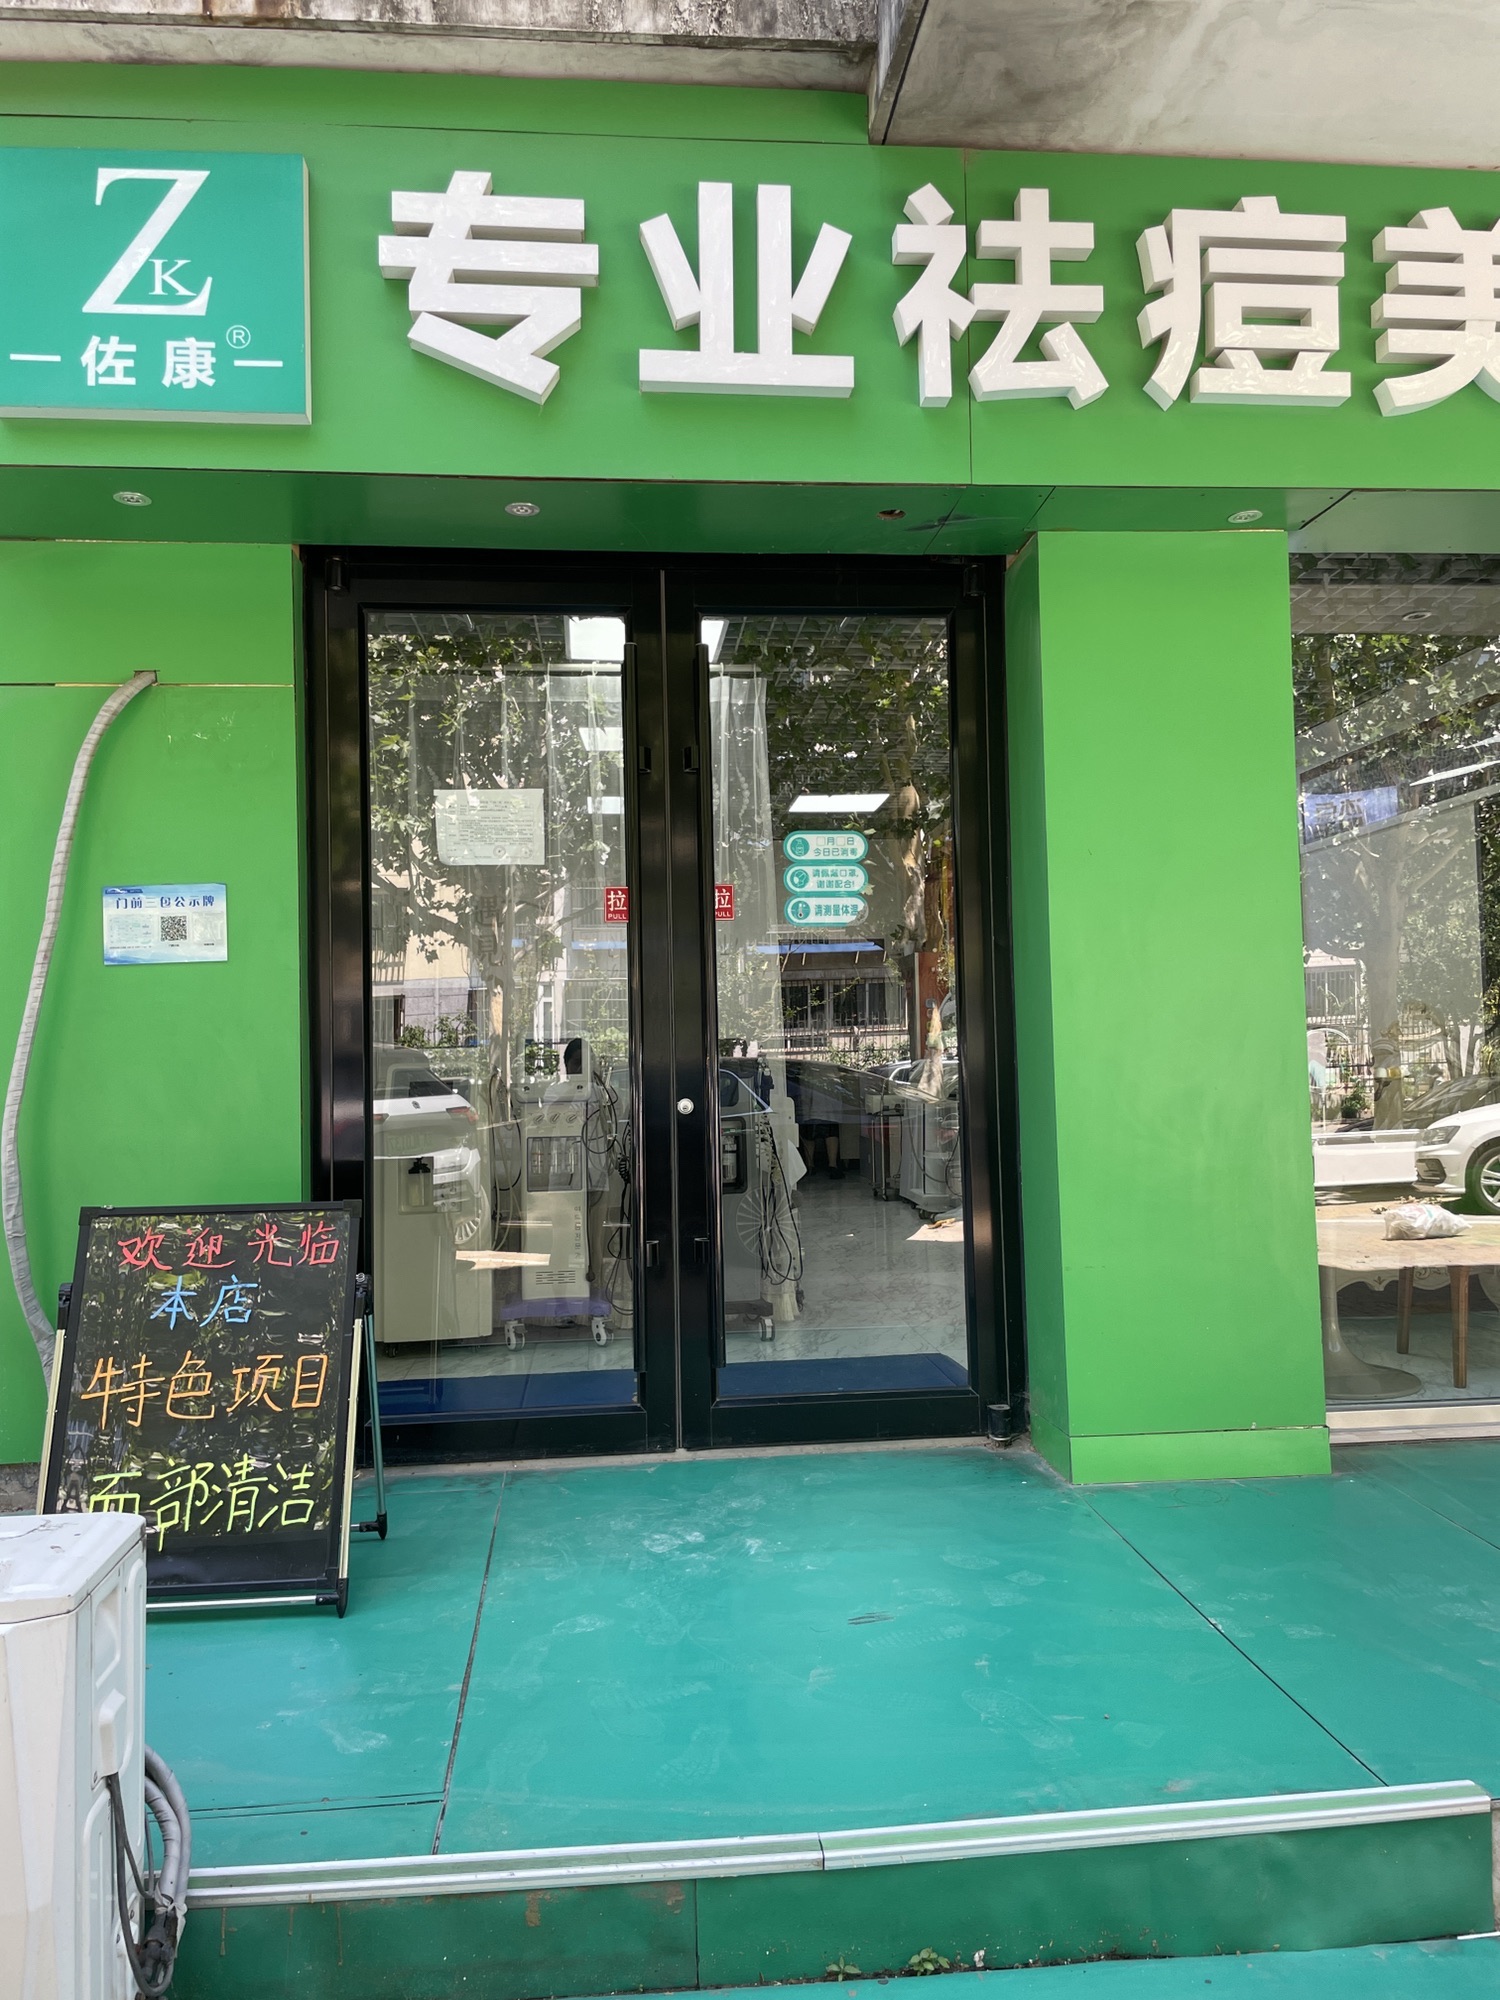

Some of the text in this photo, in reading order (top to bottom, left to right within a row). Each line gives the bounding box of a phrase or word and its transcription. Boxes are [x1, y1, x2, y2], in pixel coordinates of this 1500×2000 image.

[377, 170, 1500, 417] 专业祛痘美
[607, 890, 628, 911] 拉
[715, 888, 731, 909] 拉
[814, 904, 859, 916] 请测量体温
[117, 1222, 339, 1272] 欢迎光临
[150, 1274, 259, 1331] 本店
[80, 1350, 329, 1430] 特色项目
[88, 1453, 315, 1552] 面部清洁
